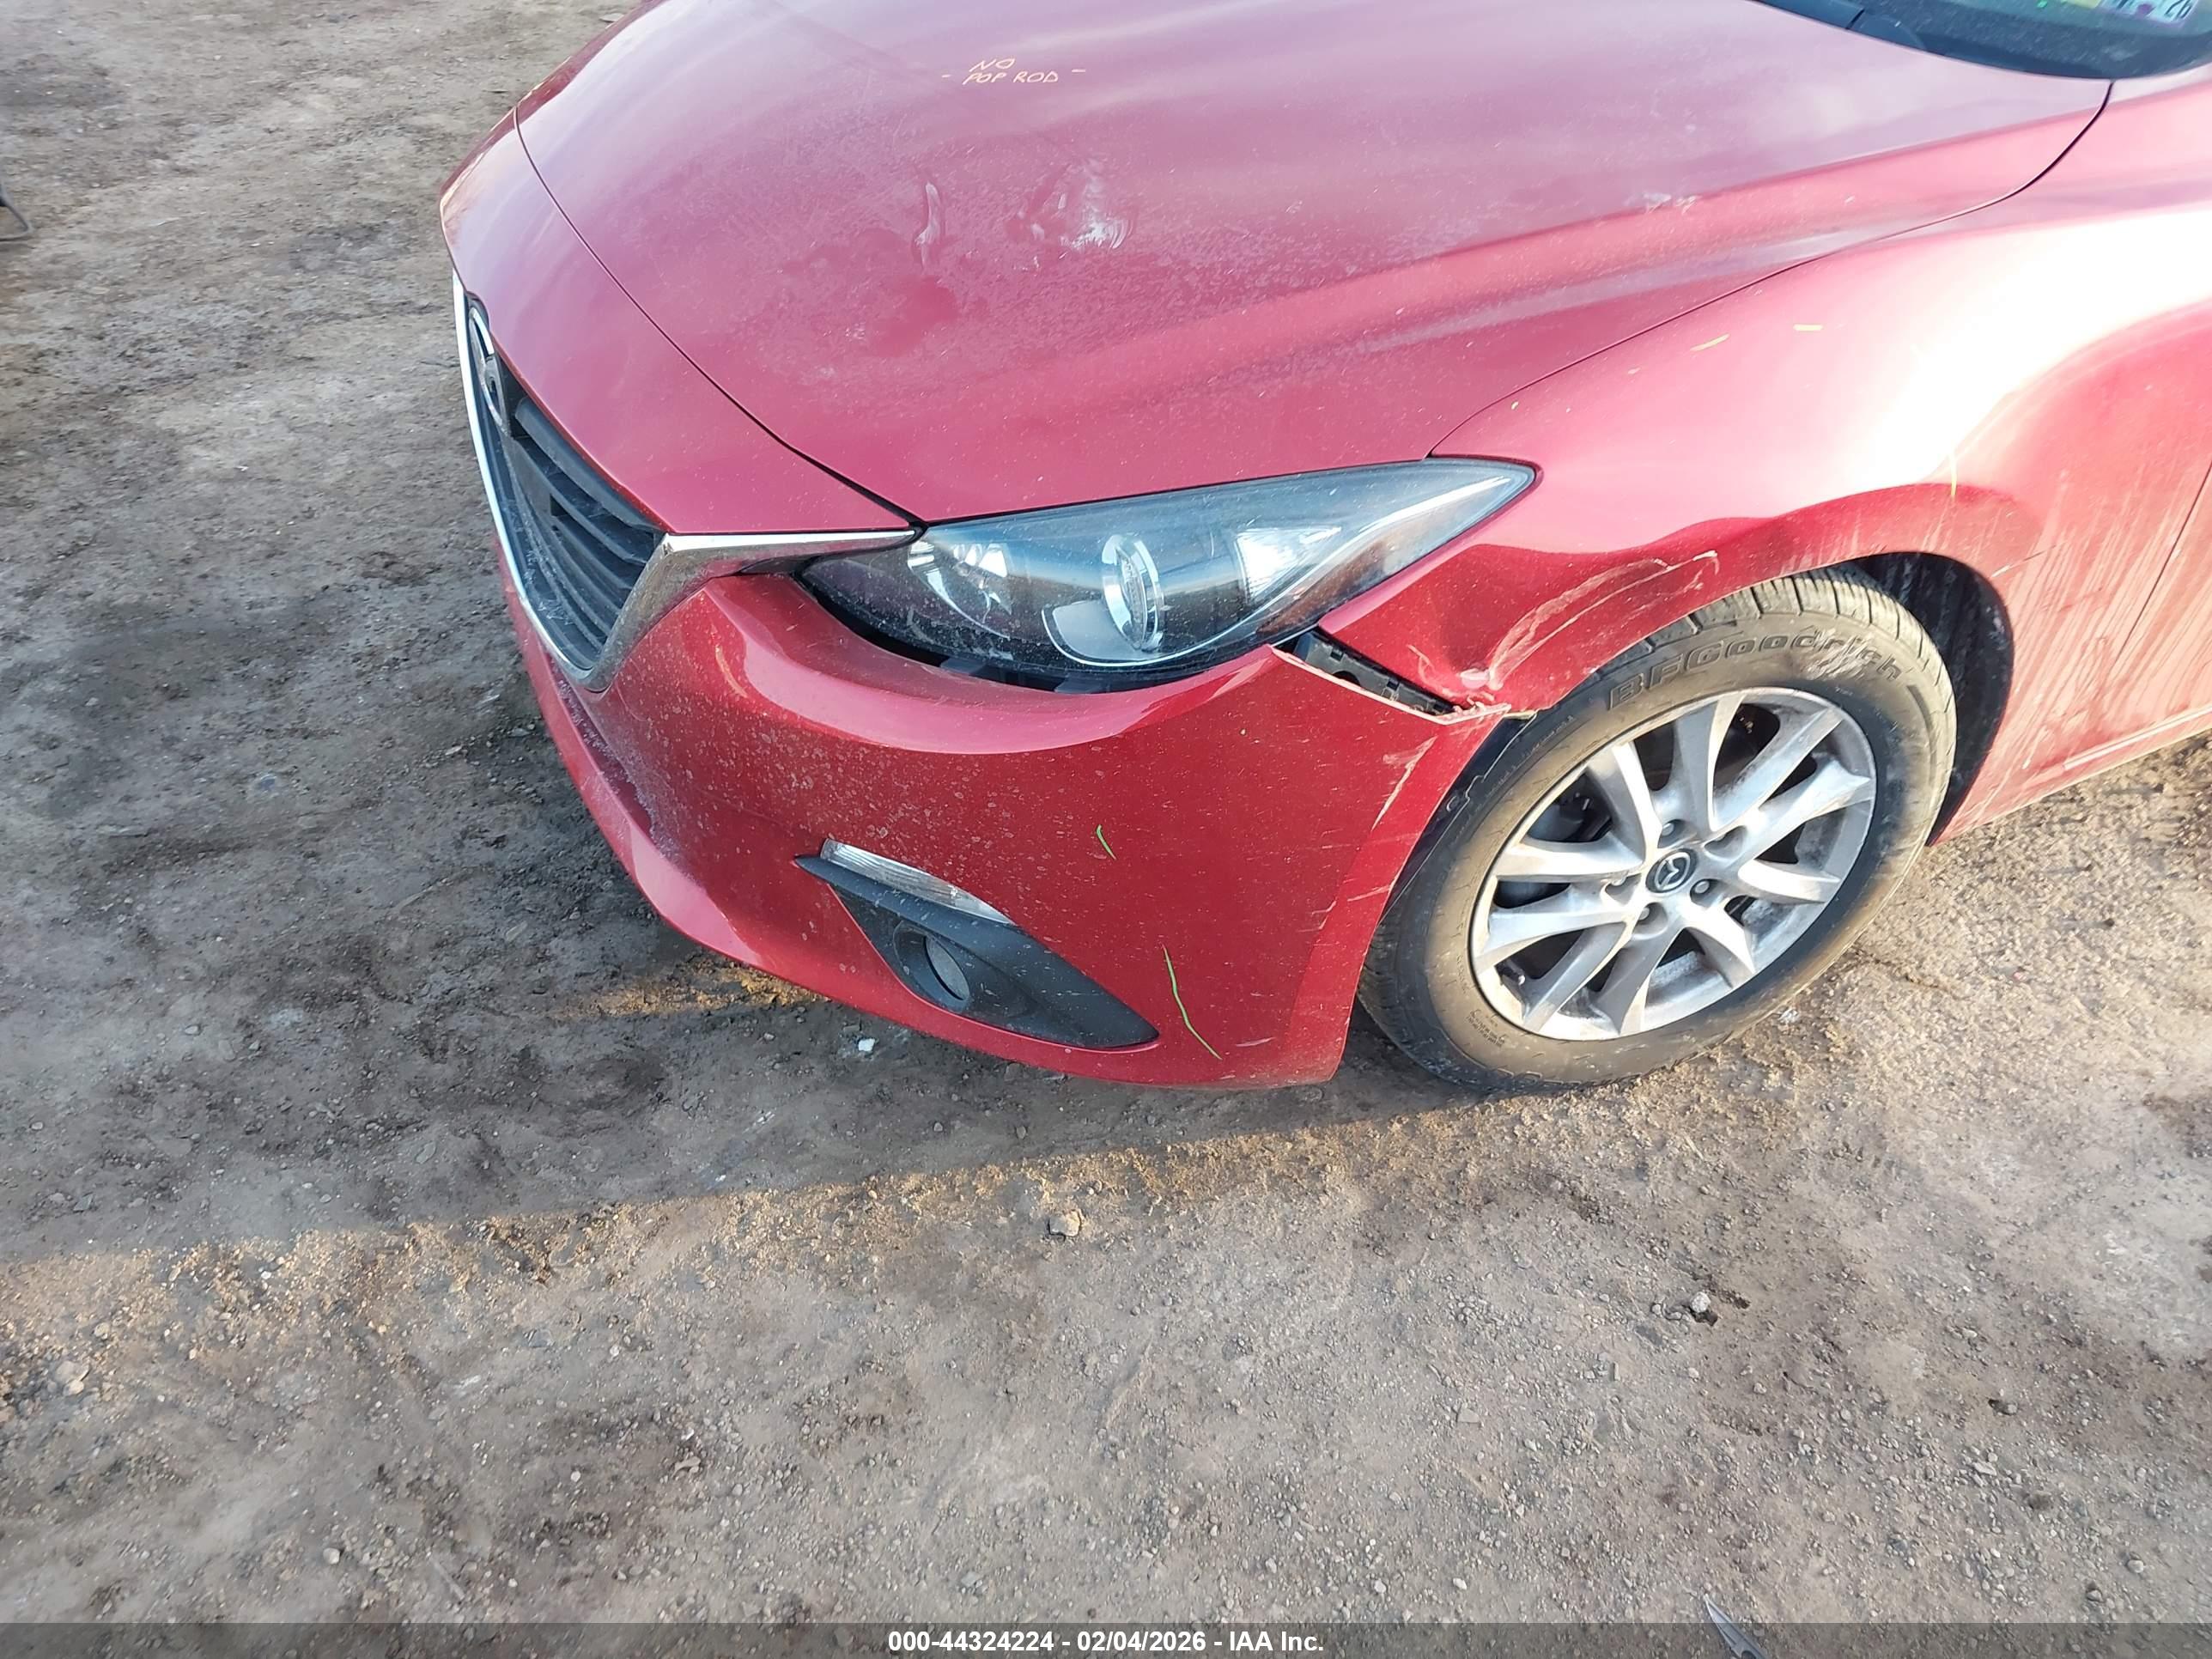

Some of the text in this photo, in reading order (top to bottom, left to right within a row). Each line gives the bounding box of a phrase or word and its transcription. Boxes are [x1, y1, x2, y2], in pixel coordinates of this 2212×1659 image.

[969, 58, 1016, 73] NO
[962, 70, 1059, 85] POP ROD
